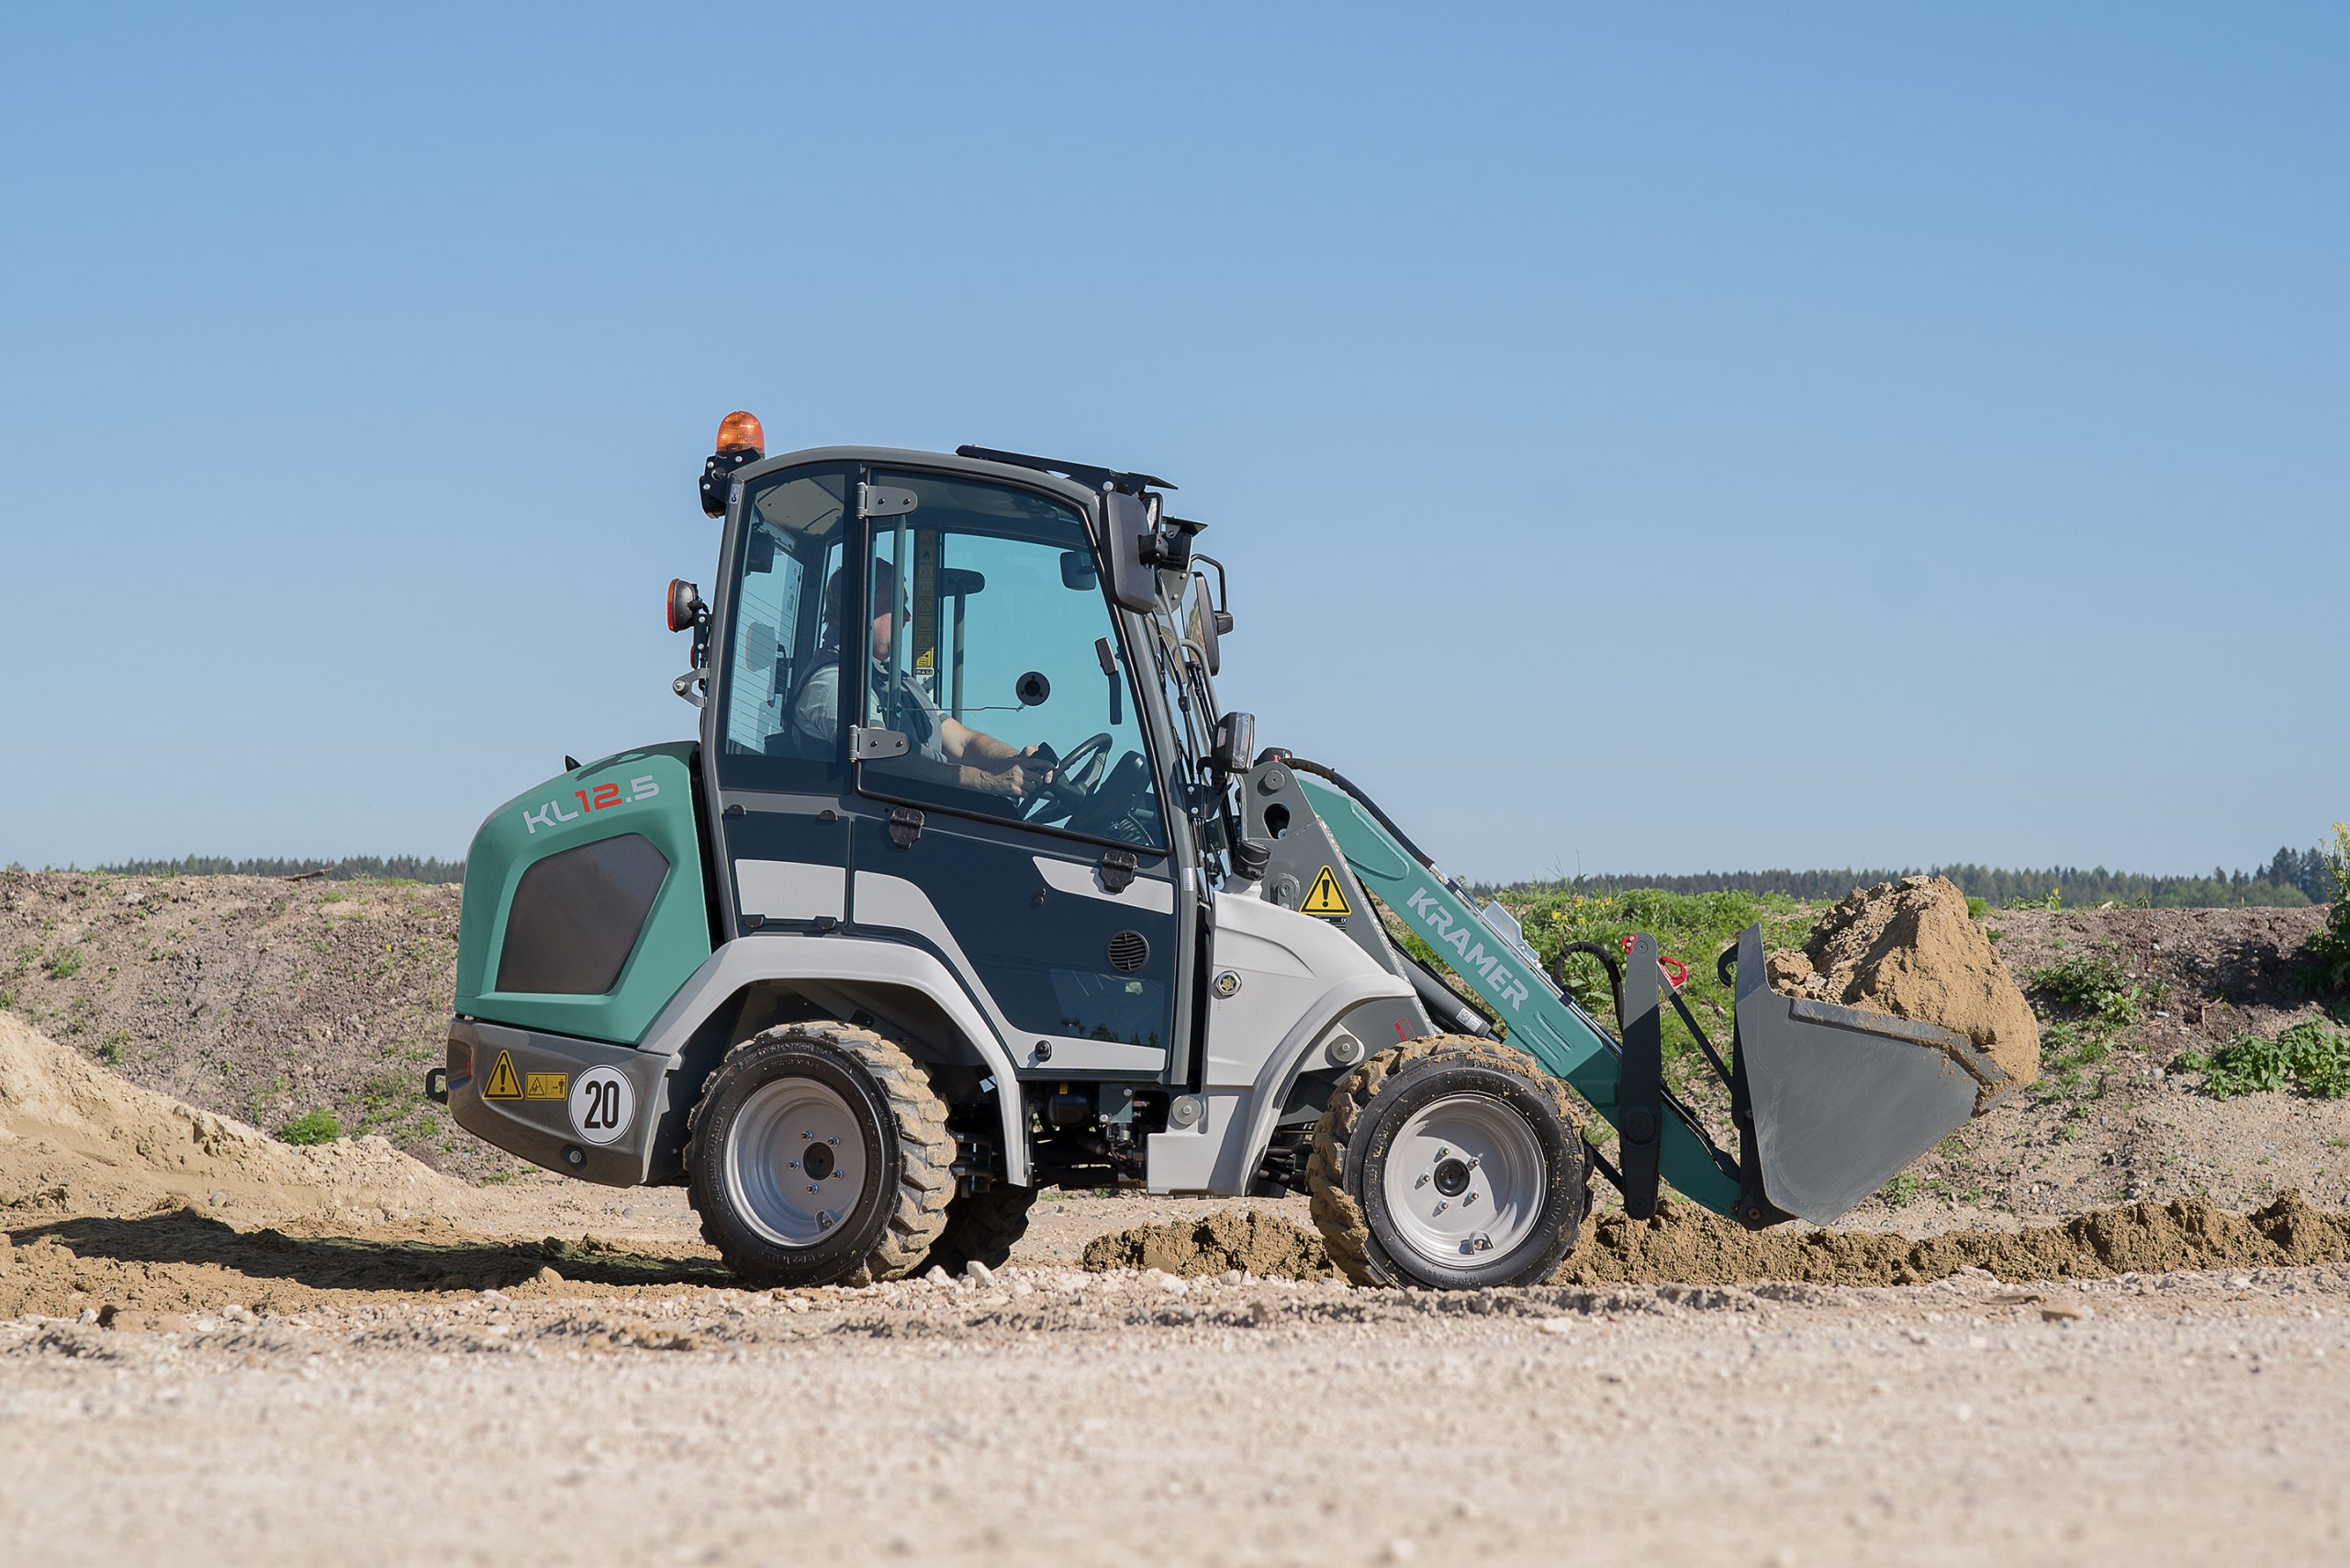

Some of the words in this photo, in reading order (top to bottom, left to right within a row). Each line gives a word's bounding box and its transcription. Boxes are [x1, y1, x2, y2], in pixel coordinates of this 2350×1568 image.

[522, 775, 660, 834] KL12.5
[1406, 887, 1529, 1012] KRAMER
[584, 1080, 621, 1129] 20
